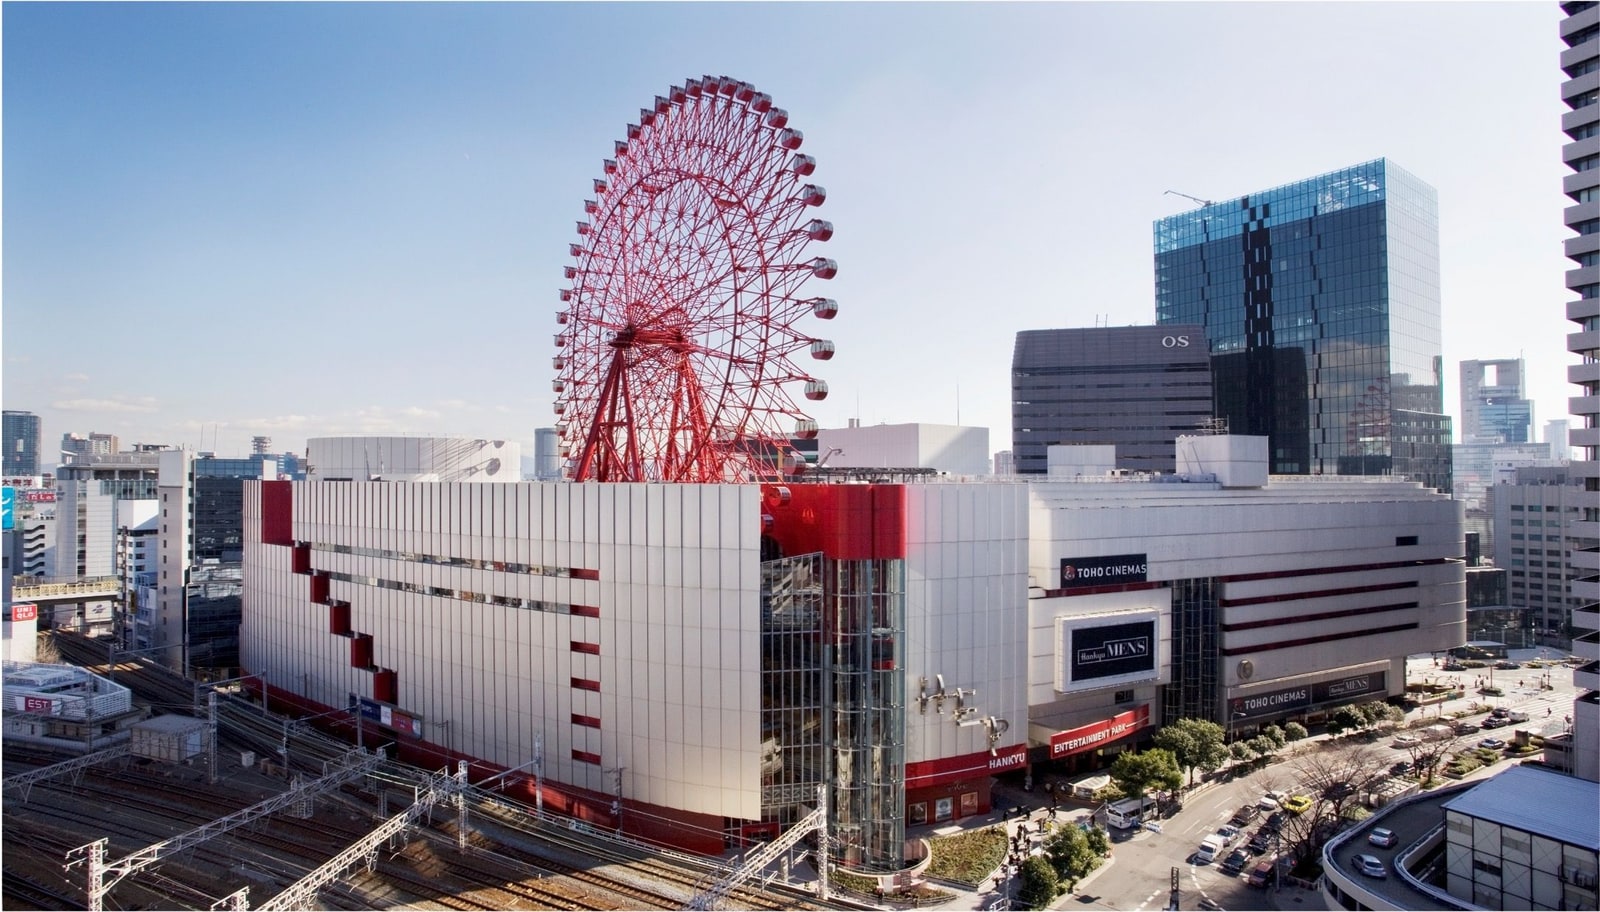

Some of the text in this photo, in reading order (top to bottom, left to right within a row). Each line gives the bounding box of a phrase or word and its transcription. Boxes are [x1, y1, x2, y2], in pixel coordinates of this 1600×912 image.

[1162, 335, 1189, 348] OS
[1077, 564, 1147, 579] TOHO CINEMAS
[16, 612, 34, 620] QLO
[1106, 640, 1146, 658] MENS
[27, 699, 49, 709] EST
[1244, 690, 1306, 710] TOHO CINEMAS
[1054, 723, 1127, 753] ENTERTAINMENT PARK
[989, 752, 1026, 769] HANKYU
